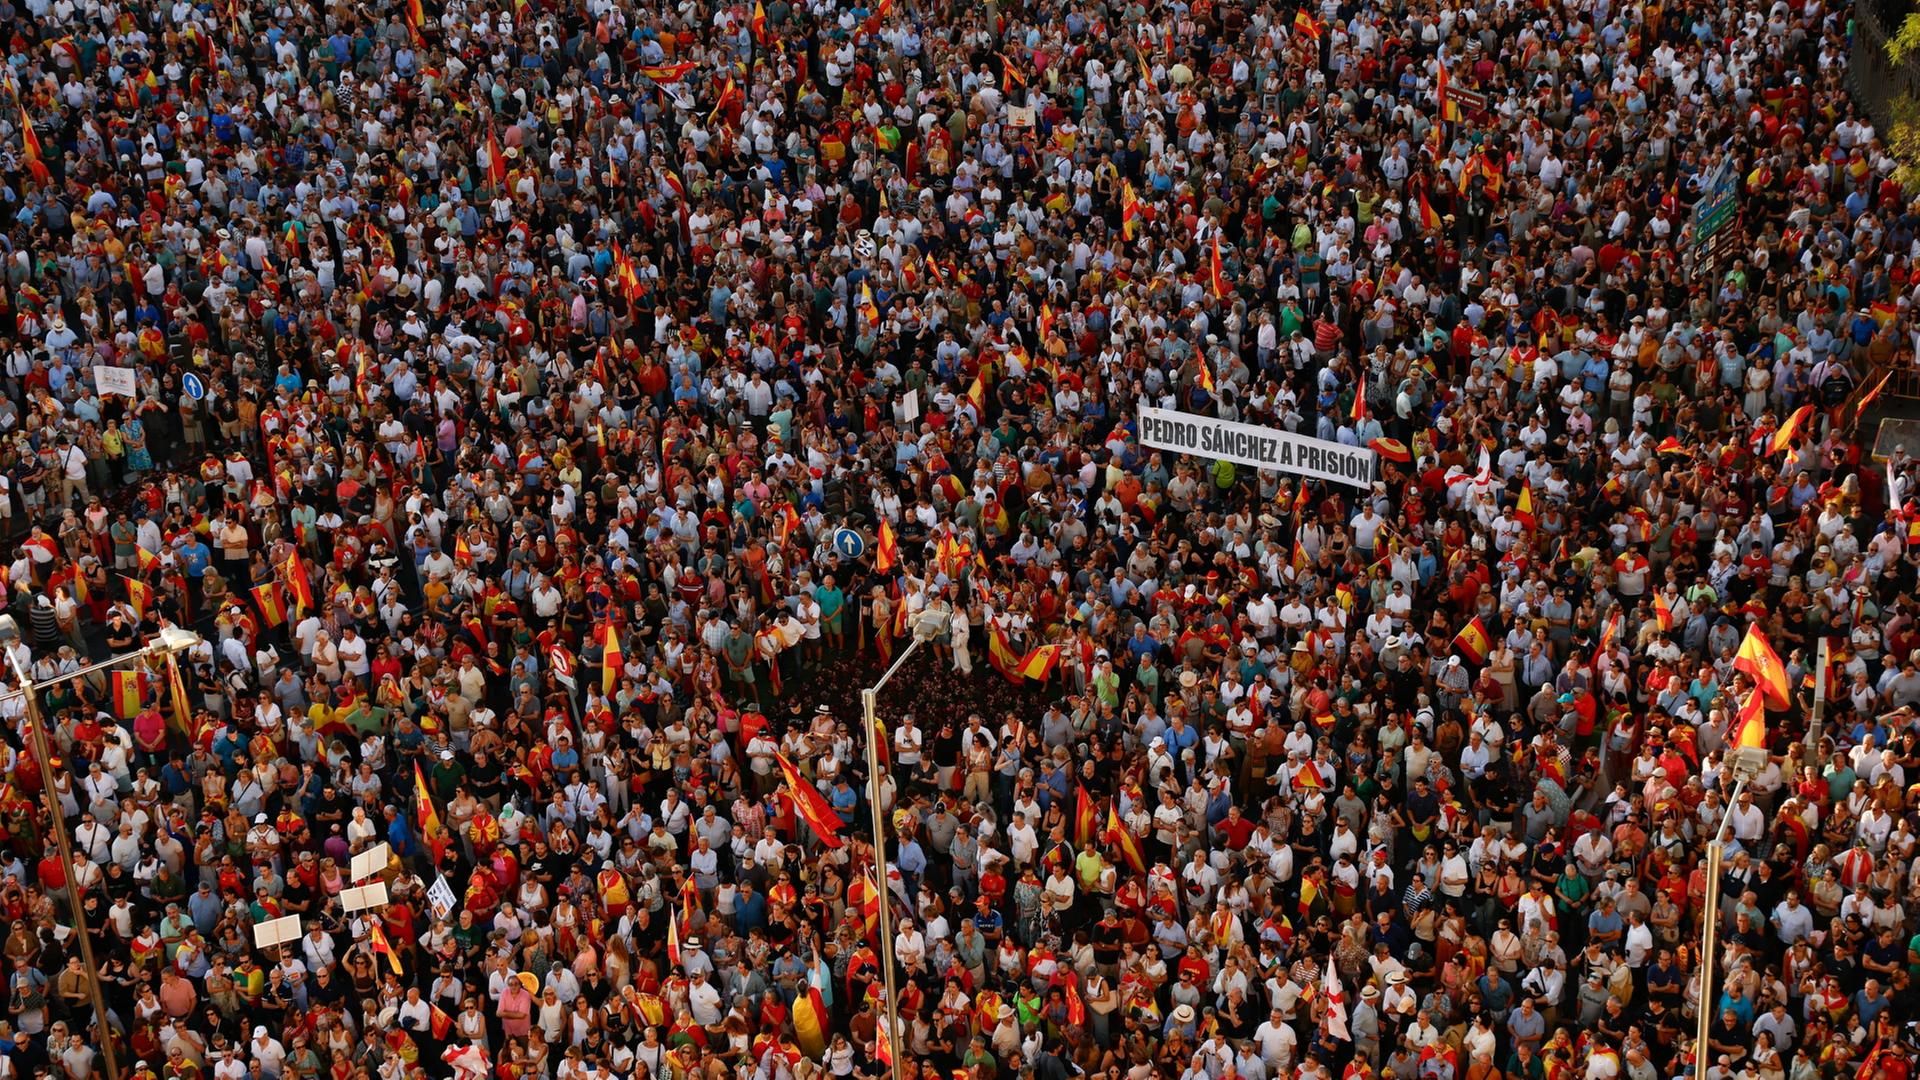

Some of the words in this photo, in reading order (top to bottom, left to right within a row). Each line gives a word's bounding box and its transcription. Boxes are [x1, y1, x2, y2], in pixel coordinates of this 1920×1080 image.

[1143, 416, 1197, 448] PEDRO
[1201, 424, 1277, 463] SÁNCHEZ
[1280, 441, 1293, 465] A
[1297, 444, 1369, 483] PRISIÓN
